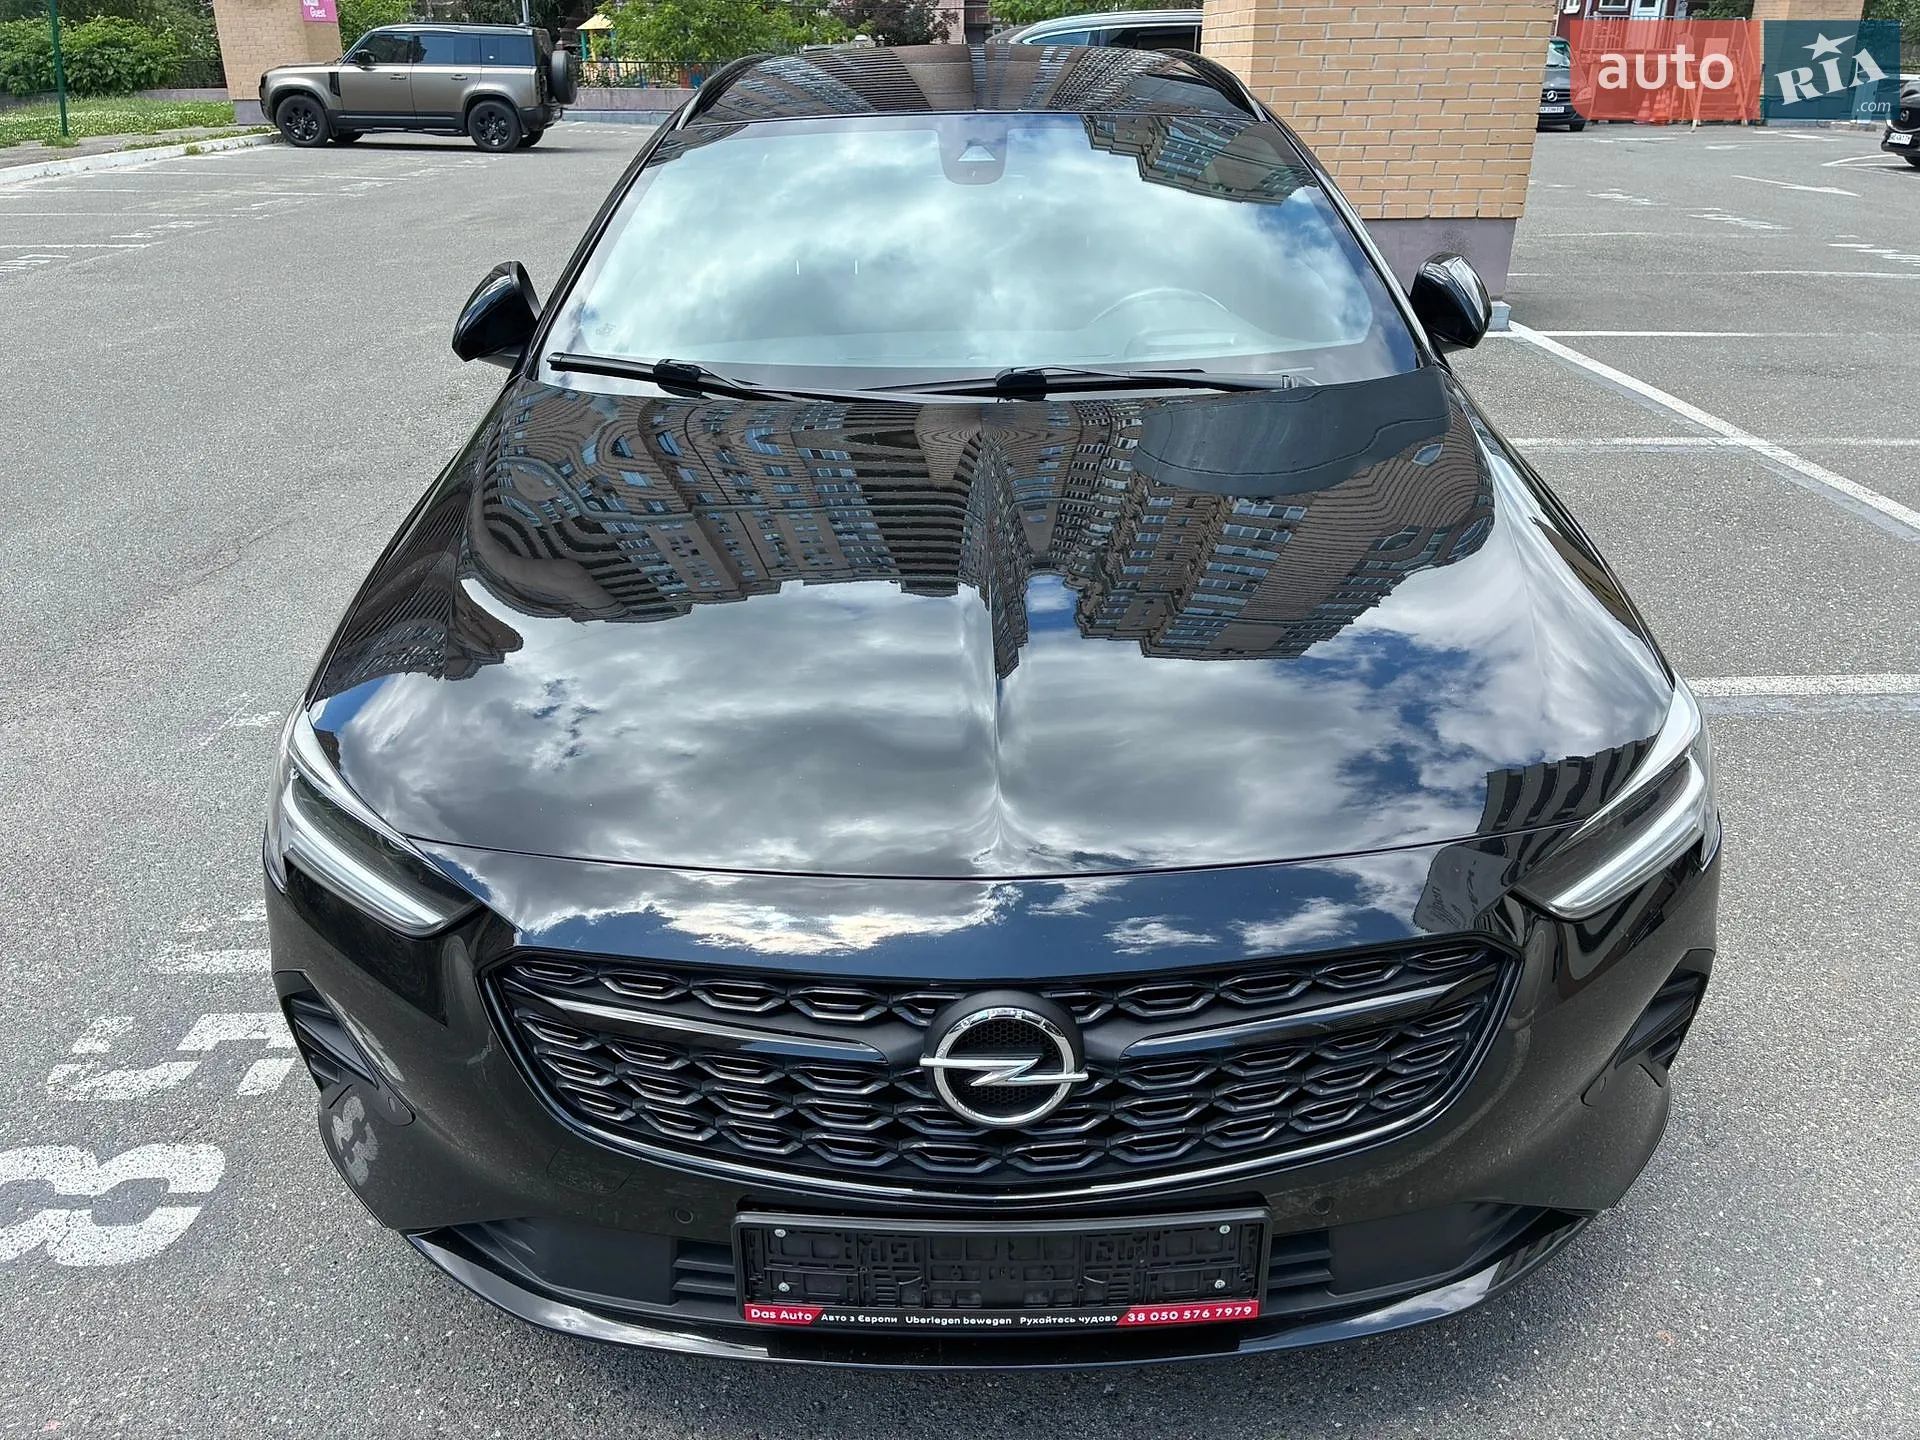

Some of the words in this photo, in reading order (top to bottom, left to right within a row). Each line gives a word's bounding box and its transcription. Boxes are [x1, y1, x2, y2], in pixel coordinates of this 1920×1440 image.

[750, 1308, 777, 1319] Das
[780, 1310, 813, 1321] Auto
[821, 1313, 847, 1322] Авто
[857, 1314, 898, 1324] Європи
[1127, 1312, 1146, 1322] 38
[1150, 1311, 1179, 1321] 050
[1183, 1309, 1210, 1319] 576
[1215, 1306, 1252, 1317] 7979
[905, 1315, 961, 1326] Uberlegen
[963, 1316, 1012, 1326] bewegen
[1019, 1316, 1076, 1326] Рухайтесь
[1078, 1315, 1118, 1324] чудово
